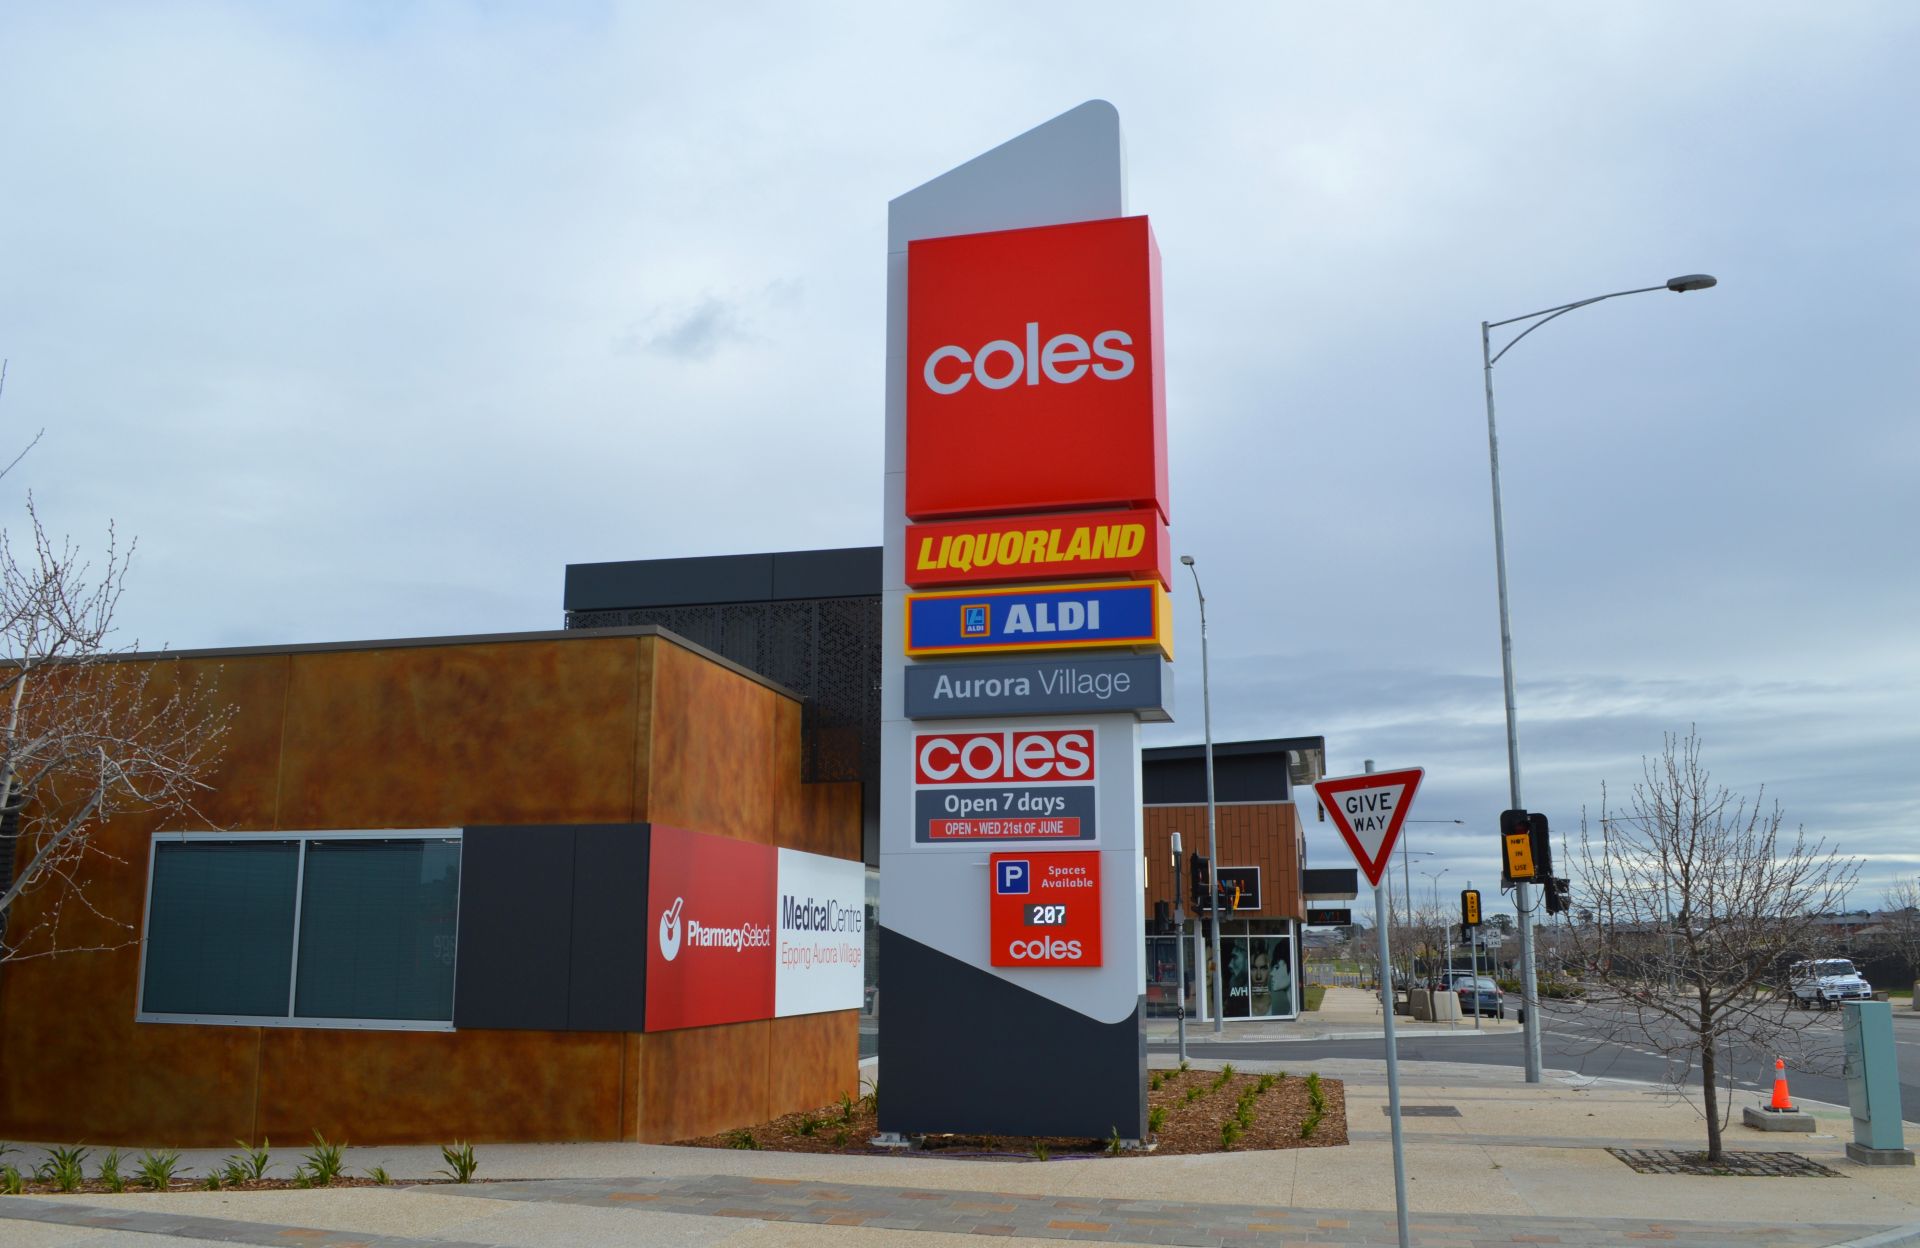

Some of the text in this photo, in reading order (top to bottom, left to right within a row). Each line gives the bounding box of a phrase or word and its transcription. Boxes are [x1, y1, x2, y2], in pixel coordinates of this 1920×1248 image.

[923, 322, 1135, 395] coles
[916, 524, 1146, 573] LIQUORLAND
[1003, 600, 1100, 634] ALDI
[933, 668, 1131, 700] Aurora Village
[919, 732, 1091, 781] coles
[944, 792, 1066, 817] Open 7 days
[1346, 792, 1392, 814] GIVE
[945, 822, 971, 835] OPEN
[979, 821, 1001, 835] WED
[1003, 821, 1022, 834] 21st
[1024, 822, 1036, 834] OF
[1038, 820, 1064, 834] JUNE
[1354, 815, 1386, 832] WAY
[1005, 865, 1086, 887] P Spaces
[1041, 878, 1094, 888] Available
[1033, 905, 1066, 924] 207
[687, 920, 770, 953] PharmacySelect
[1009, 935, 1083, 960] coles
[782, 941, 862, 970] Epping Aurora Village
[1230, 986, 1248, 997] AVH
